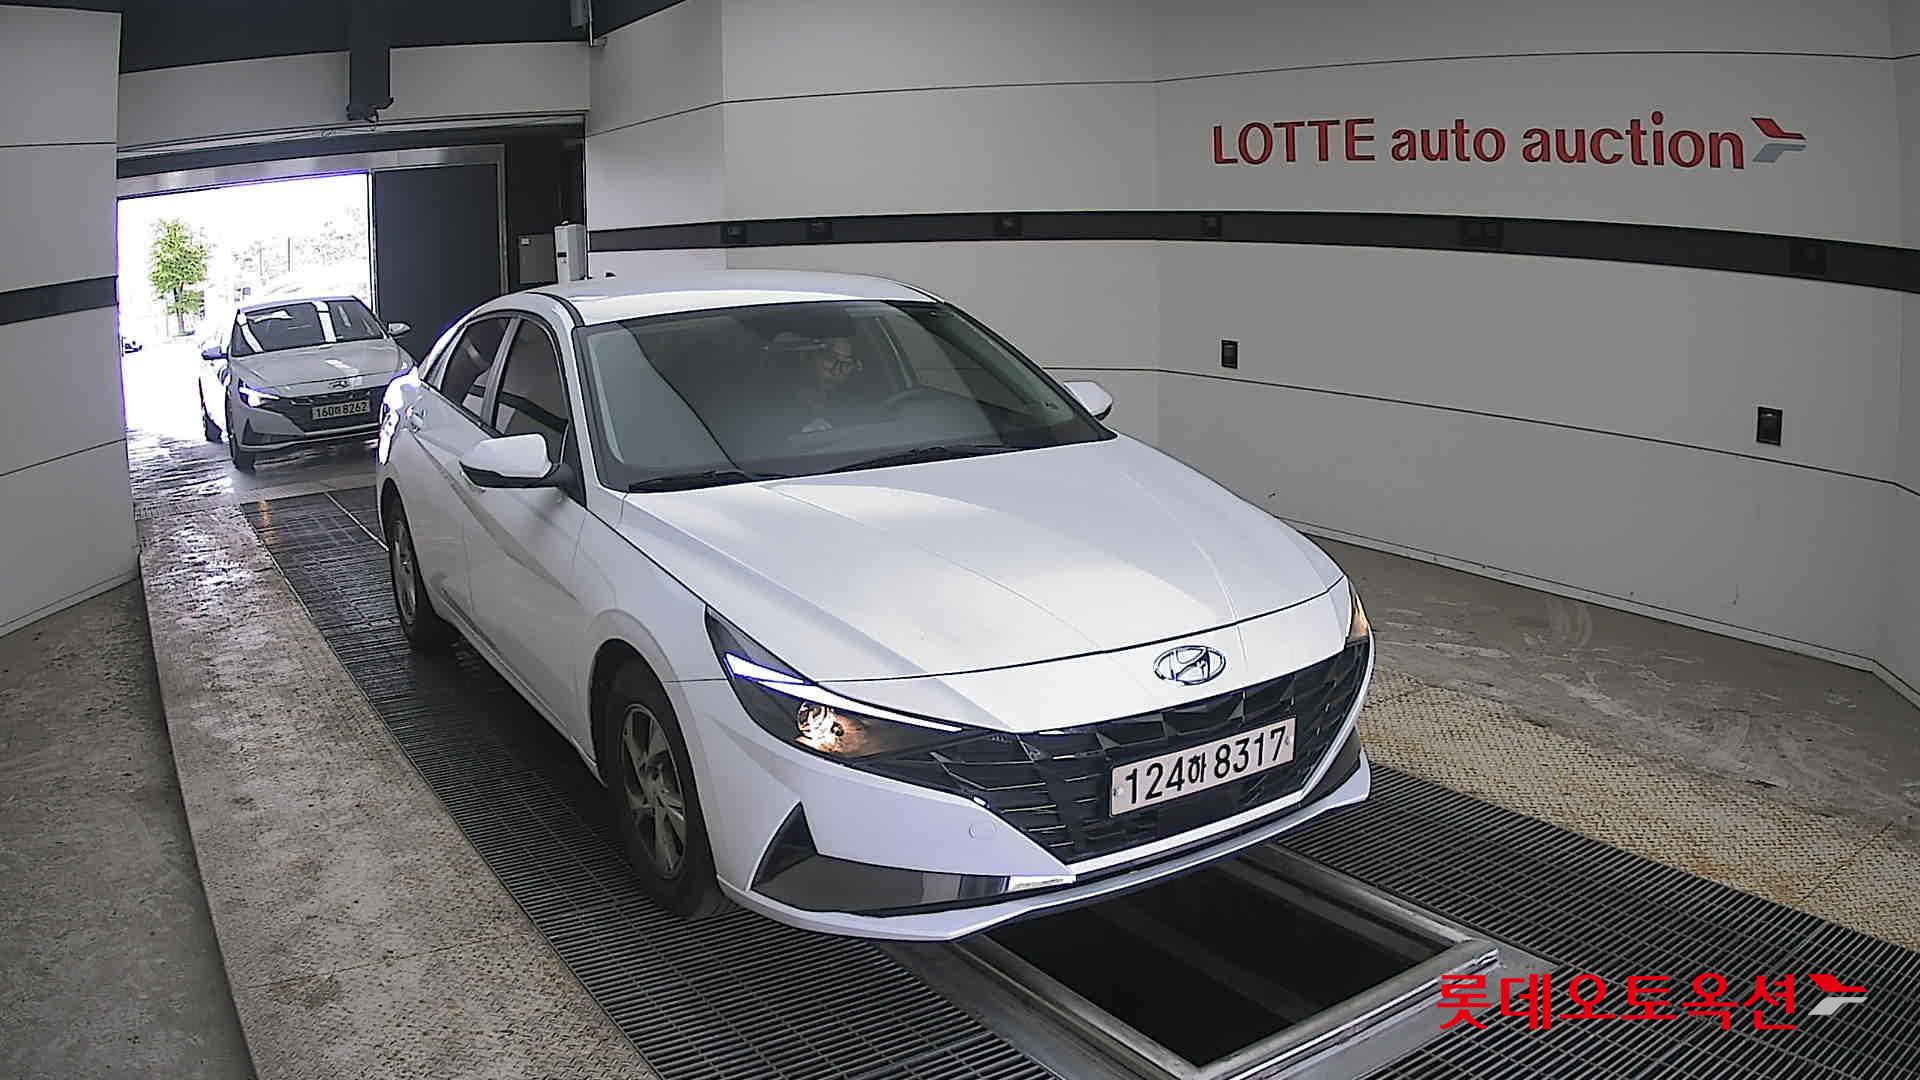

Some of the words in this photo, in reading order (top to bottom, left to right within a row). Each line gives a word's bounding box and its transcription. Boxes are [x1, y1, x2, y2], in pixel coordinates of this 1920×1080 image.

[1213, 118, 1376, 165] LOTTE
[1390, 118, 1507, 162] auto
[1521, 110, 1745, 170] auction
[1125, 752, 1207, 804] 124하
[1214, 726, 1286, 779] 8317
